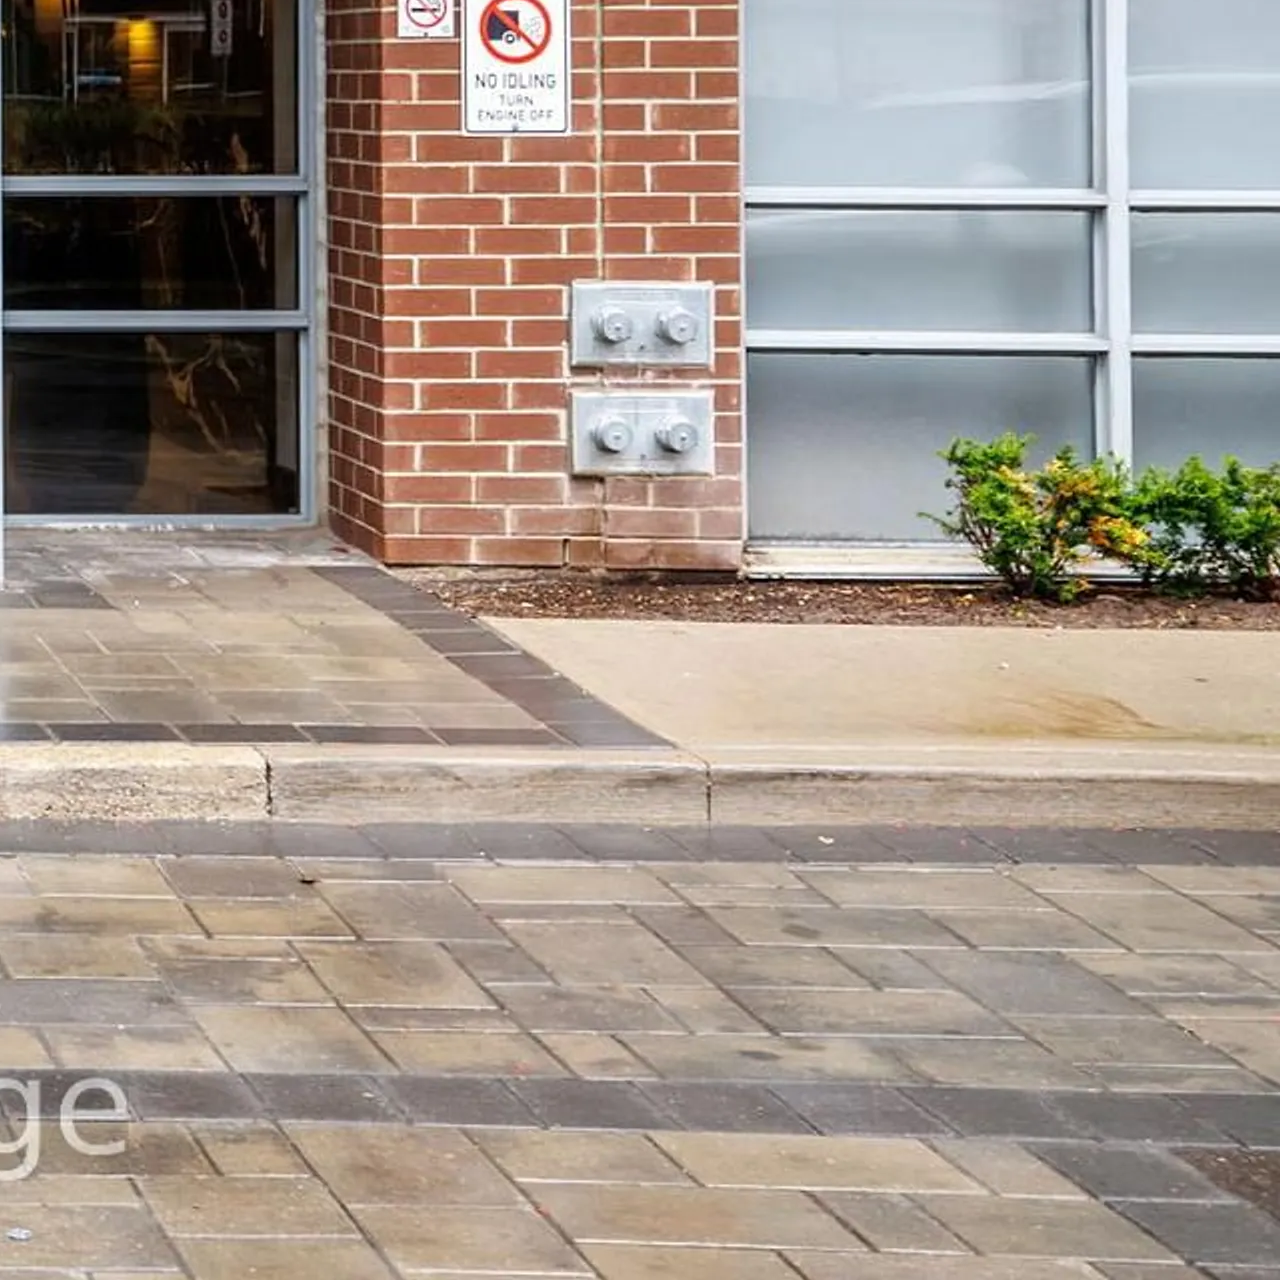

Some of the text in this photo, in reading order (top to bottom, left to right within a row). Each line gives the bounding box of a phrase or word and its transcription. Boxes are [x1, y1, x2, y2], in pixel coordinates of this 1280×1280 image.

[474, 73, 556, 89] NO IDLING
[499, 93, 534, 106] TURN
[477, 109, 554, 121] ENGINE OFF
